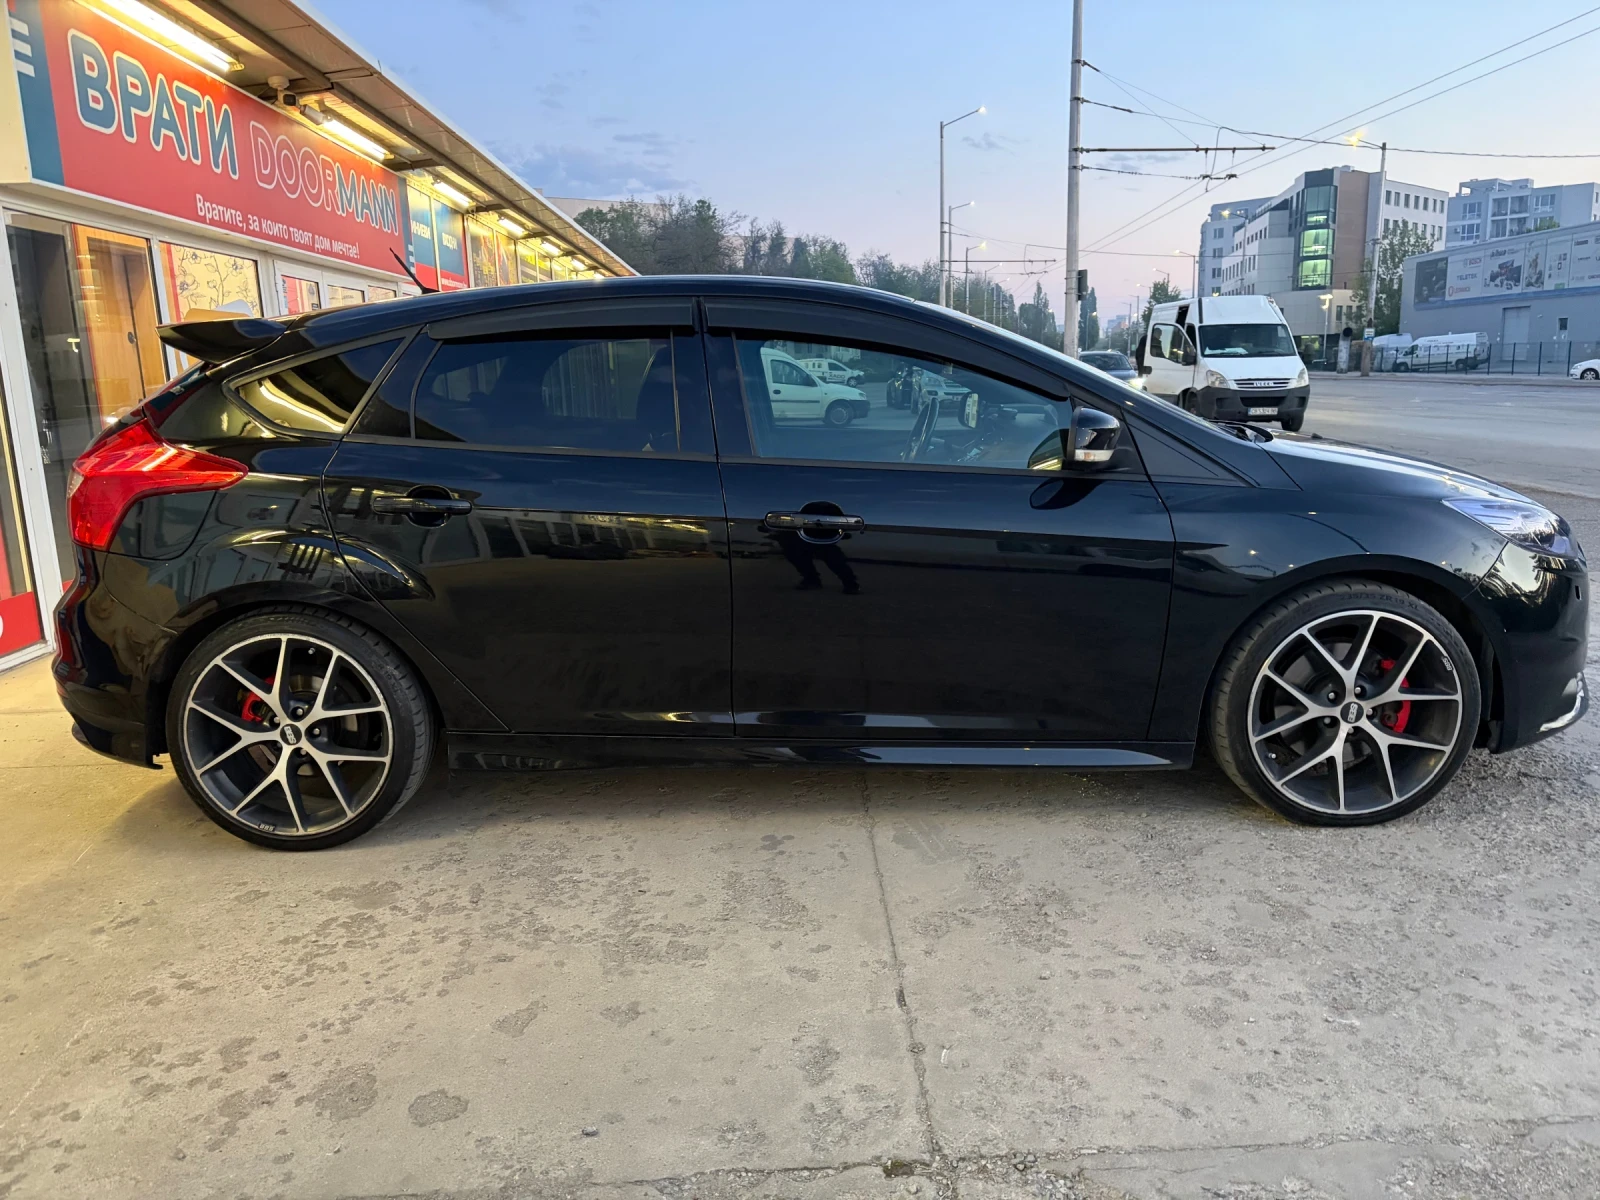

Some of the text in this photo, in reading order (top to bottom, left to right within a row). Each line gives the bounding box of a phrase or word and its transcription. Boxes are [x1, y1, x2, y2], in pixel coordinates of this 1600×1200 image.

[67, 28, 239, 180] ВРАТИ
[195, 193, 360, 259] Вратите, за които твоят дом мечтае!
[250, 120, 399, 237] DOORMANN
